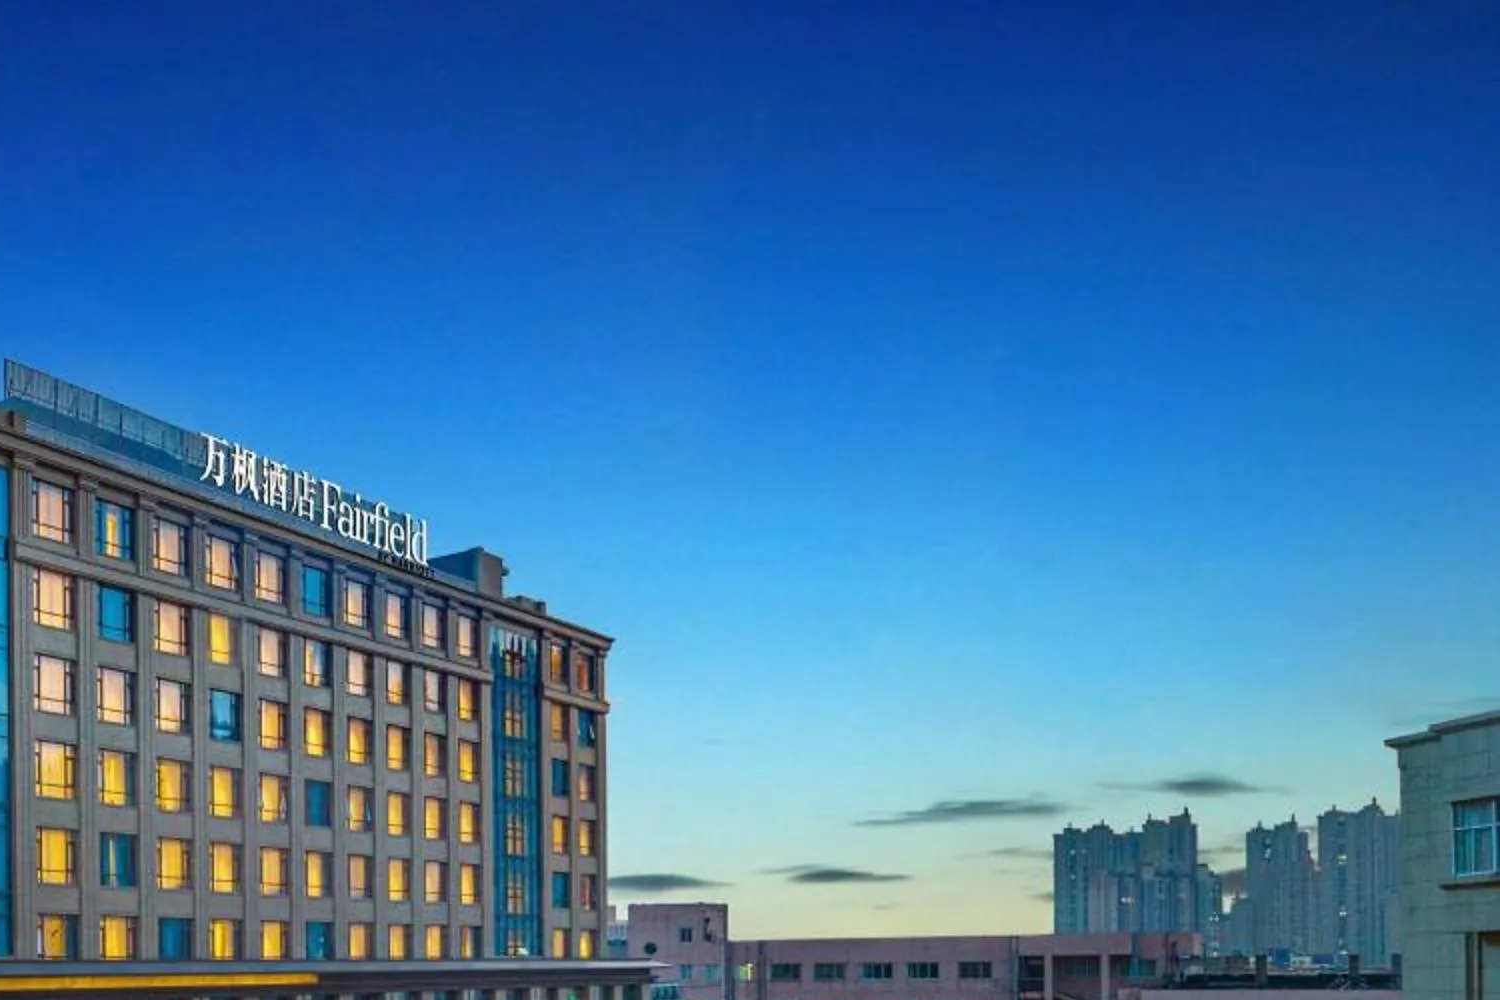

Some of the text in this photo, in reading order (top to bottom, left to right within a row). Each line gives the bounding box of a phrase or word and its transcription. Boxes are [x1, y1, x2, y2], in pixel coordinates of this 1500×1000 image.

[200, 432, 429, 567] 万枫酒店 Fairfield
